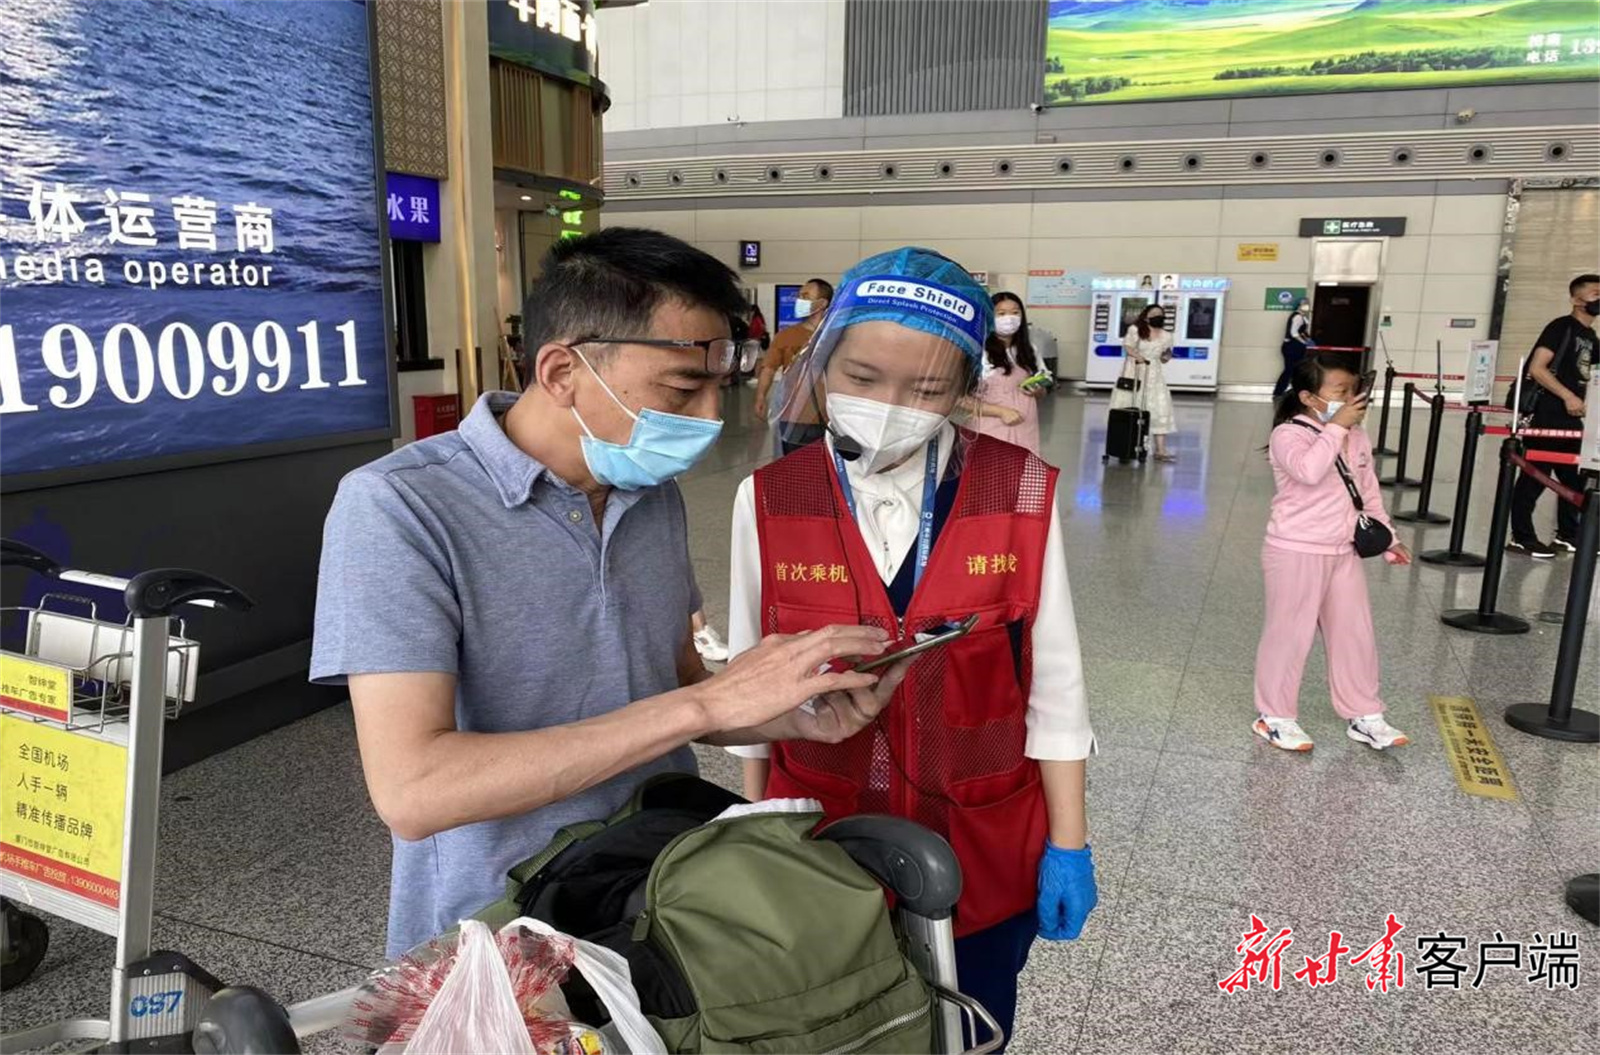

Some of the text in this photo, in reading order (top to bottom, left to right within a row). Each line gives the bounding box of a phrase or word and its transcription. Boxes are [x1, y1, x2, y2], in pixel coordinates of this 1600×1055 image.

[0, 181, 274, 254] 体运营商
[386, 192, 430, 224] 水果
[124, 258, 273, 290] operator
[867, 282, 967, 315] Face Shield
[867, 297, 957, 323] Direct Splash Protection
[0, 319, 367, 414] 19009911
[774, 562, 848, 583] 首次乘机
[18, 743, 69, 772] 全国机场
[17, 772, 68, 802] 人手一辆
[16, 801, 93, 840] 精准传播品牌
[130, 990, 183, 1018] 097
